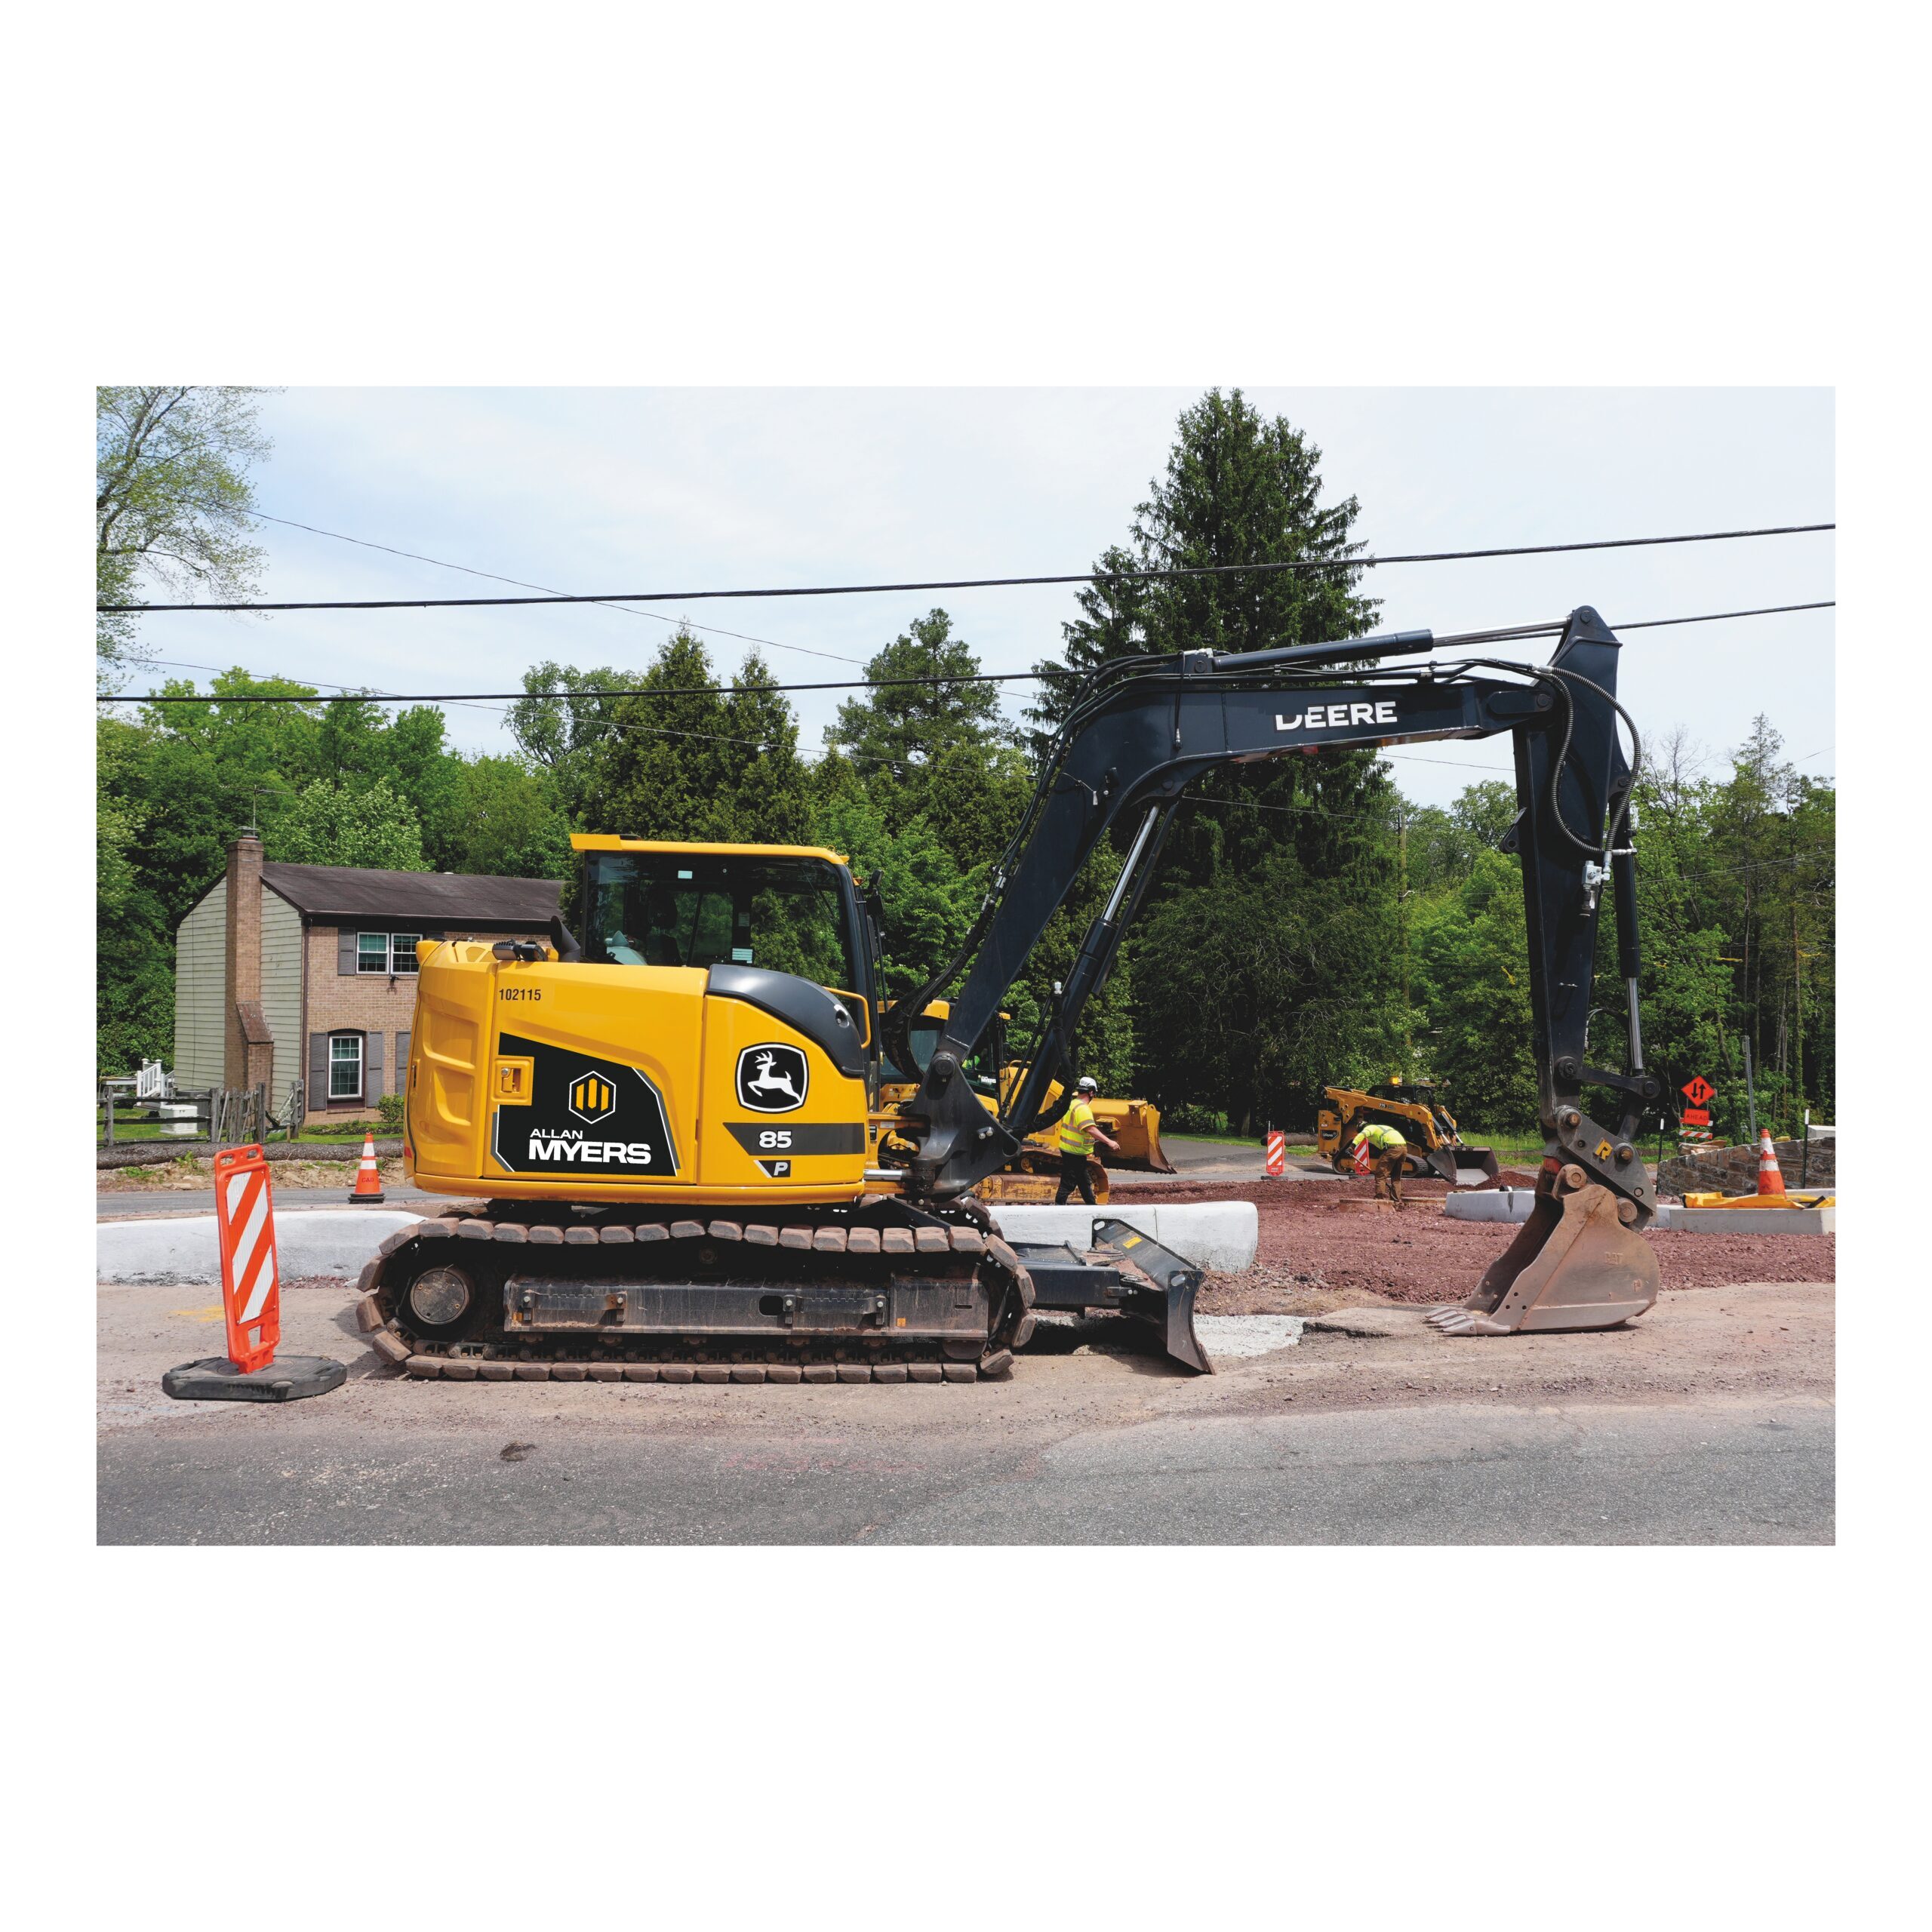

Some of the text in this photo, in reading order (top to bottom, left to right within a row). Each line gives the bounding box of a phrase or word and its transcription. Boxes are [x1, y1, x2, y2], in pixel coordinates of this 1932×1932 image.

[1275, 701, 1397, 731] DEERE
[499, 989, 541, 1001] 102115
[530, 1128, 583, 1139] ALLAN
[758, 1131, 792, 1149] 85
[529, 1140, 651, 1164] MYERS
[774, 1162, 788, 1176] P
